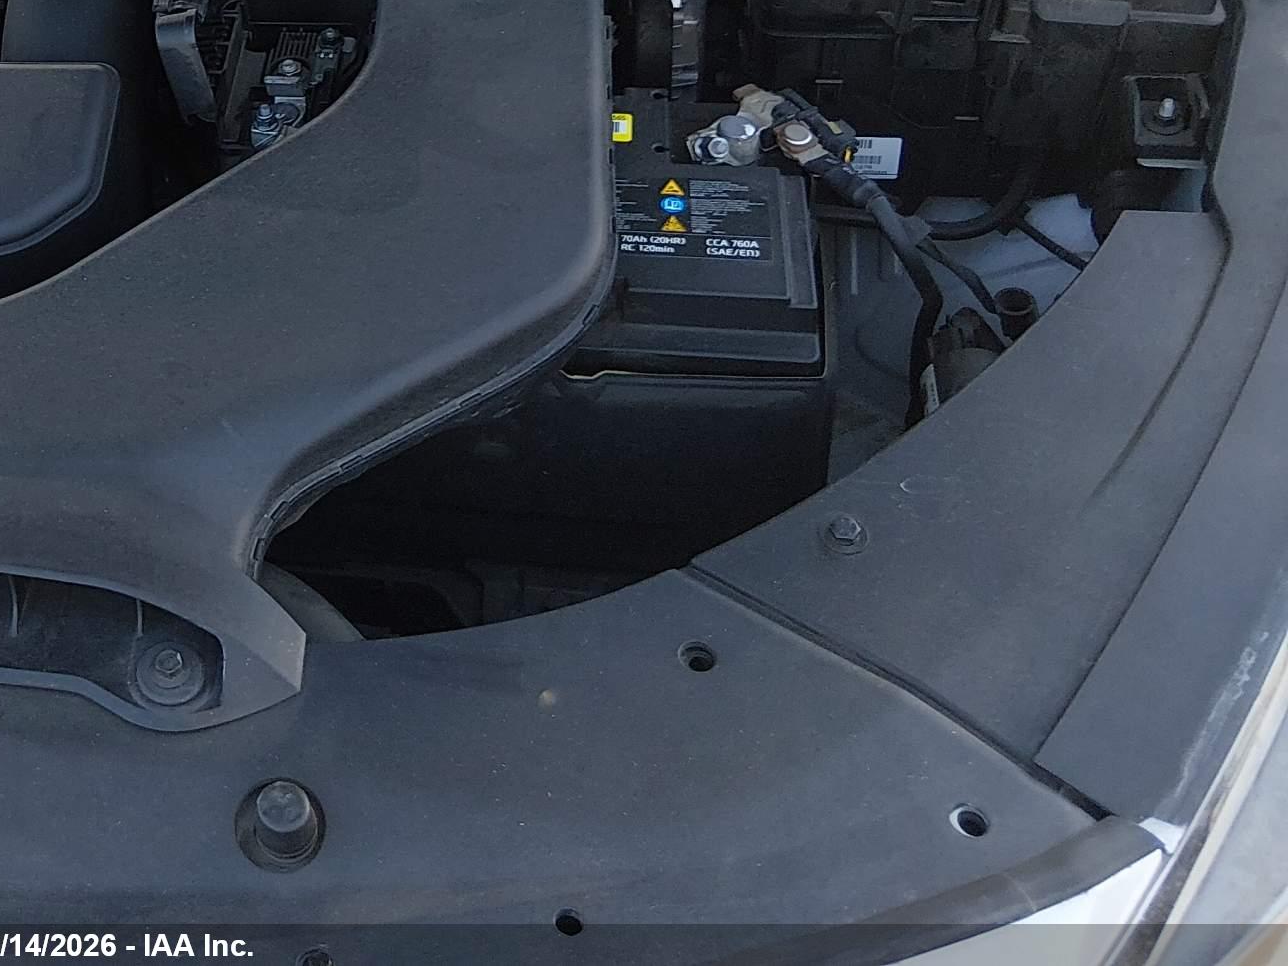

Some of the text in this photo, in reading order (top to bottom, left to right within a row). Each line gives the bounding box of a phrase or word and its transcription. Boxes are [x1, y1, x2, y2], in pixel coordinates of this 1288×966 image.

[620, 235, 647, 243] 70Ah
[705, 238, 760, 249] CCA 760A
[620, 243, 675, 253] RC 120min
